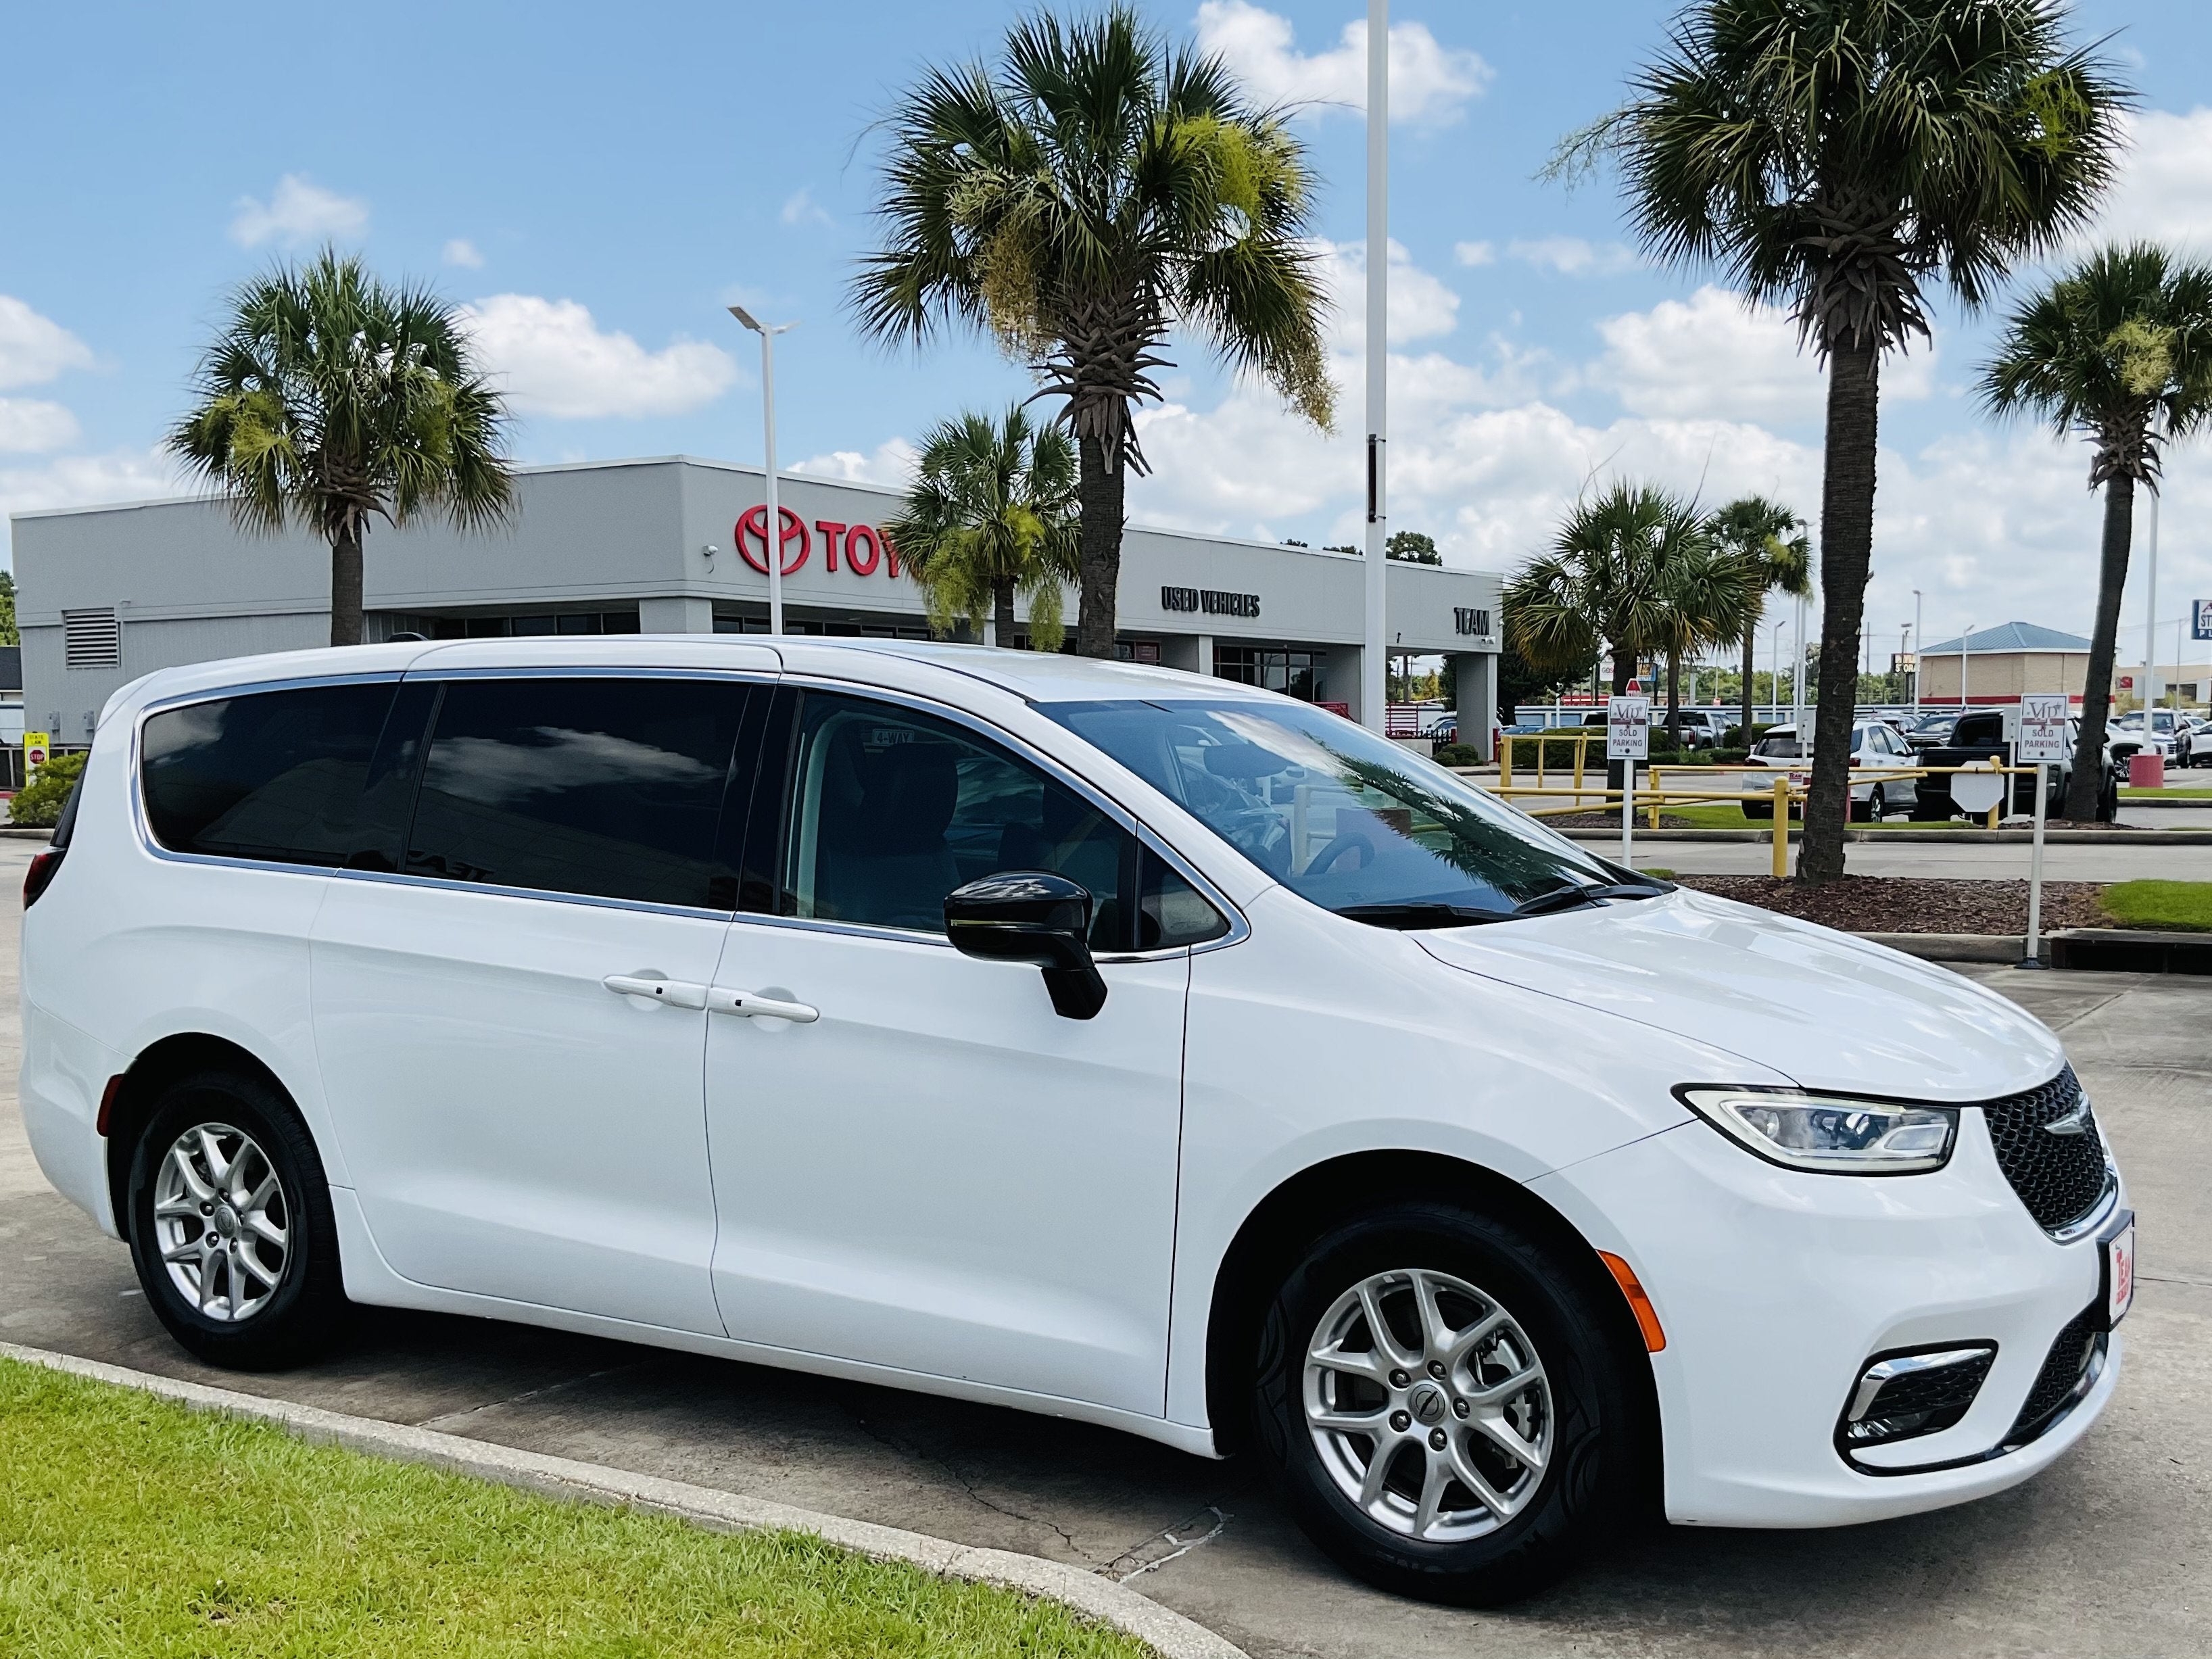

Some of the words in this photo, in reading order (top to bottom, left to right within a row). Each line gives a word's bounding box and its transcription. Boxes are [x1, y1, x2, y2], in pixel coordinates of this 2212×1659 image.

[816, 521, 899, 578] TOY
[1161, 586, 1199, 611] USED
[1200, 590, 1260, 617] VEHICLES
[1454, 607, 1489, 635] TEAM
[877, 731, 910, 744] 4-WAY
[1612, 739, 1643, 747] PARKING
[2024, 740, 2060, 748] PARKING
